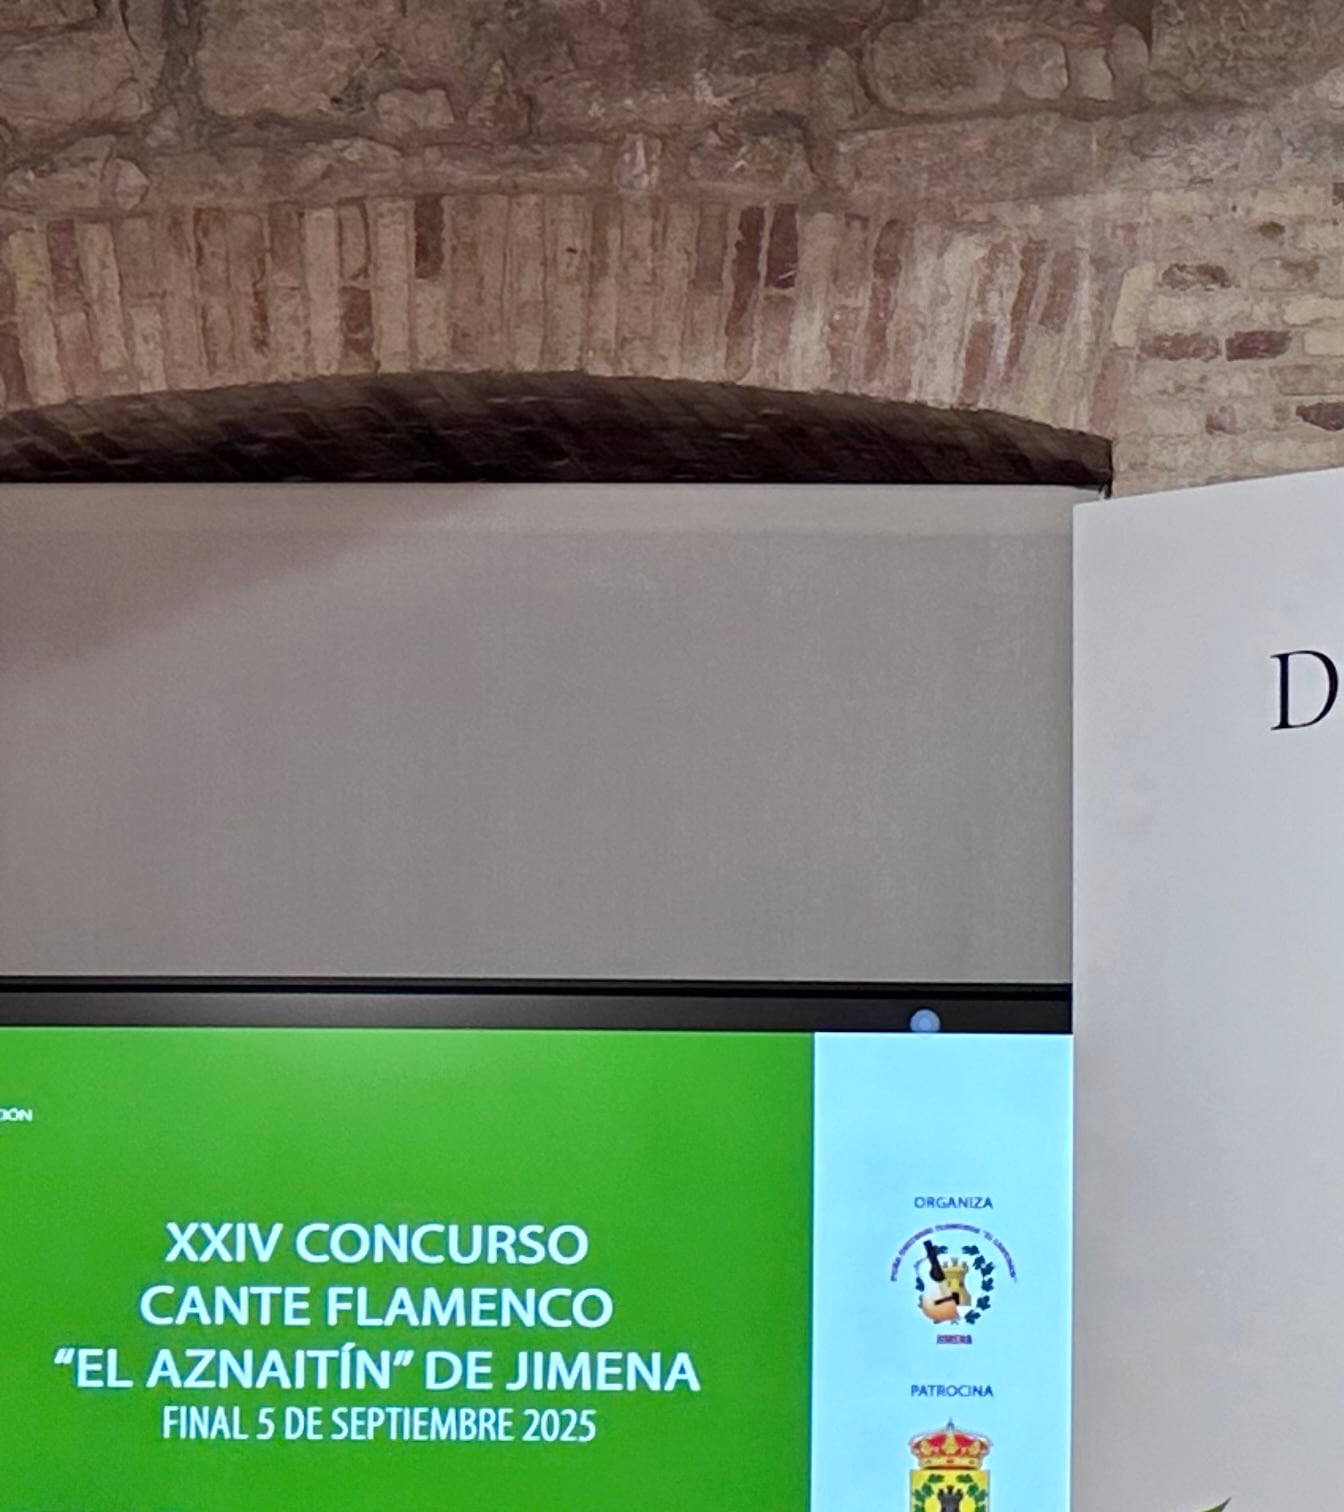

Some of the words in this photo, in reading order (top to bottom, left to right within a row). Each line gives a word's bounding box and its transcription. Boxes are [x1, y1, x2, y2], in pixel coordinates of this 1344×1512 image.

[914, 1196, 993, 1209] ORGANIZA
[165, 1222, 283, 1262] XXIV
[295, 1222, 589, 1265] CONCURSO
[139, 1284, 311, 1326] CANTE
[327, 1285, 613, 1328] FLAMENCO
[425, 1350, 493, 1390] DE
[505, 1351, 700, 1391] JIMENA
[910, 1384, 994, 1397] PATROCINA
[163, 1405, 248, 1440] FINAL
[256, 1406, 275, 1440] 5
[284, 1406, 323, 1440] DE
[331, 1406, 512, 1441] SEPTIEMBRE
[522, 1408, 596, 1442] 2025
